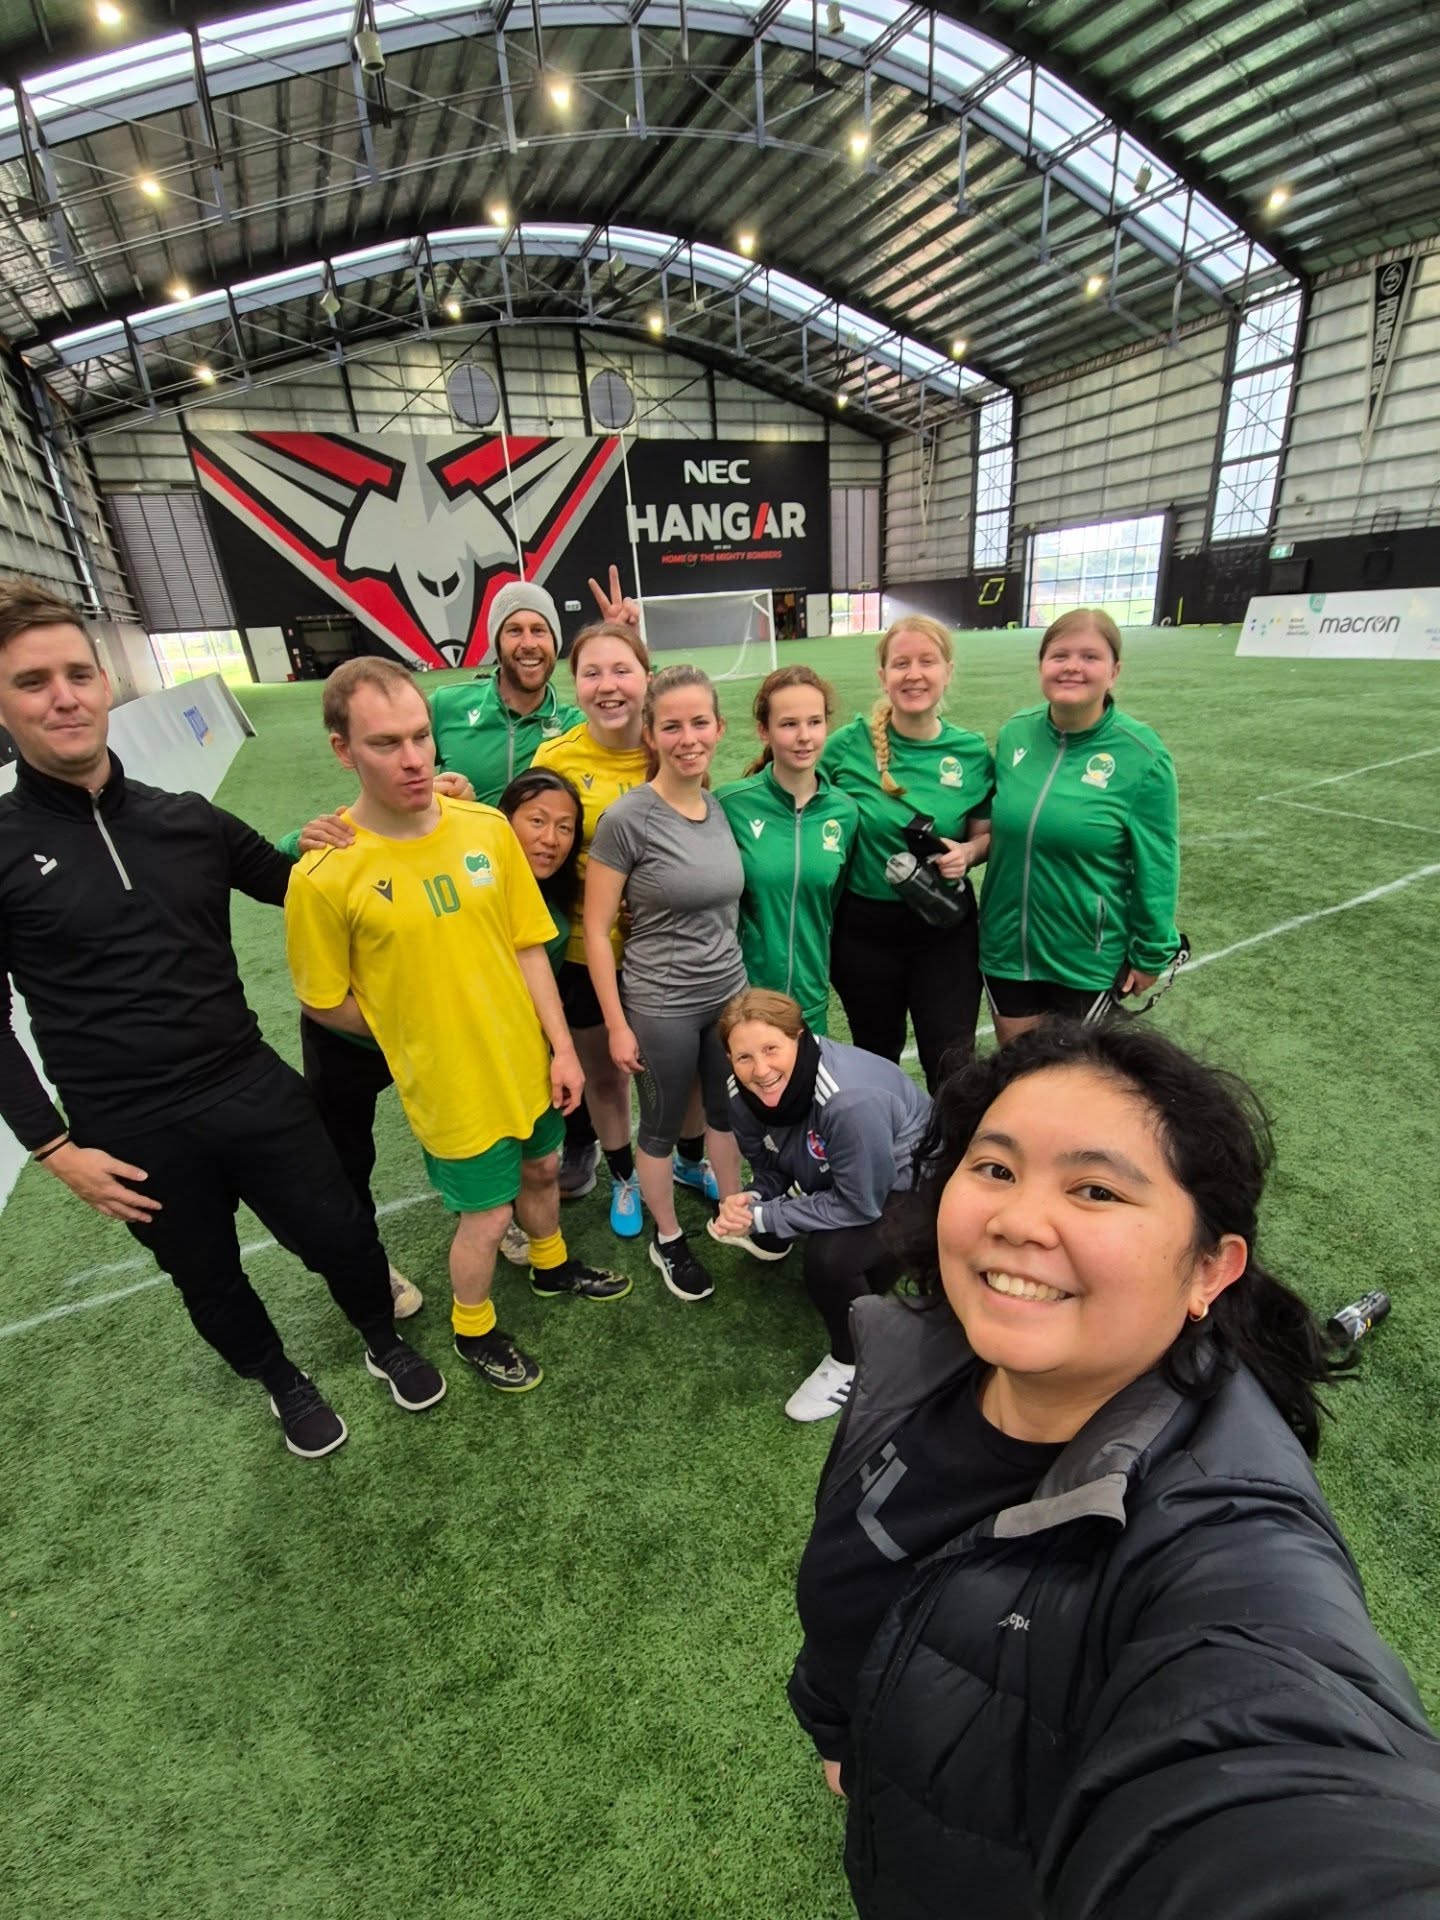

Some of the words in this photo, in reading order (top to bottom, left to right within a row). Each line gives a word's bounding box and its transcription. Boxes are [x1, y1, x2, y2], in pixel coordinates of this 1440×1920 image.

[684, 459, 750, 484] NEC
[626, 502, 806, 543] HANGAR
[661, 554, 686, 564] HOME
[687, 554, 699, 563] OF
[700, 553, 715, 561] THE
[715, 552, 746, 560] MIGHTY
[746, 550, 782, 560] BOMBERS
[1319, 616, 1400, 633] macron
[423, 874, 461, 917] 10
